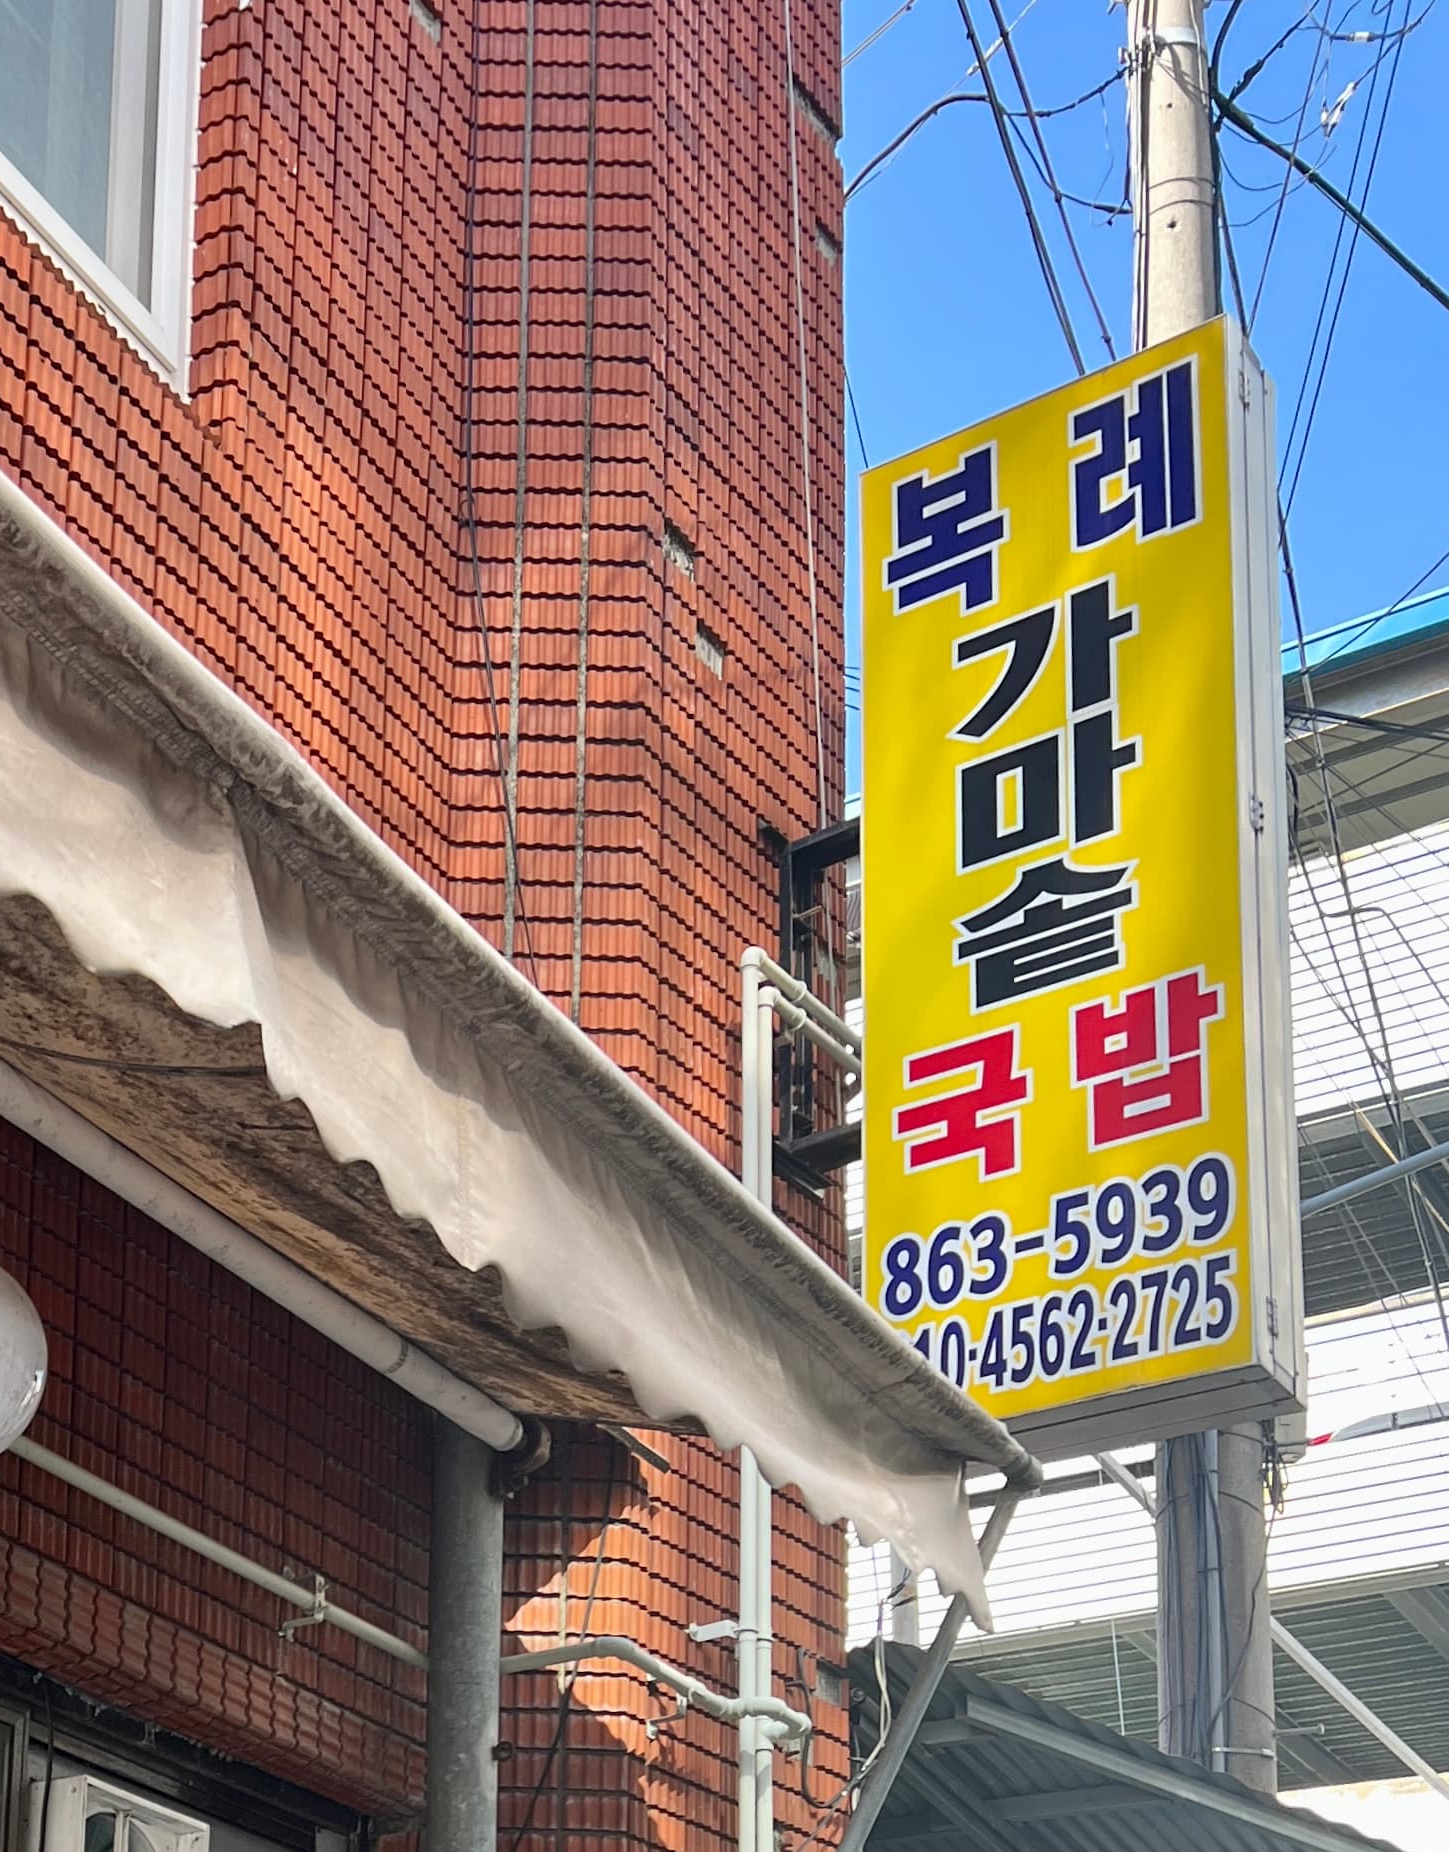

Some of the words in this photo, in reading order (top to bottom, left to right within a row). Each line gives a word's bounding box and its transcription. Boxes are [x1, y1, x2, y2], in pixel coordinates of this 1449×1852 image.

[886, 360, 1198, 612] 복례
[955, 580, 1136, 1008] 가마솥
[897, 971, 1219, 1177] 국밥
[883, 1157, 1231, 1317] 863-5939
